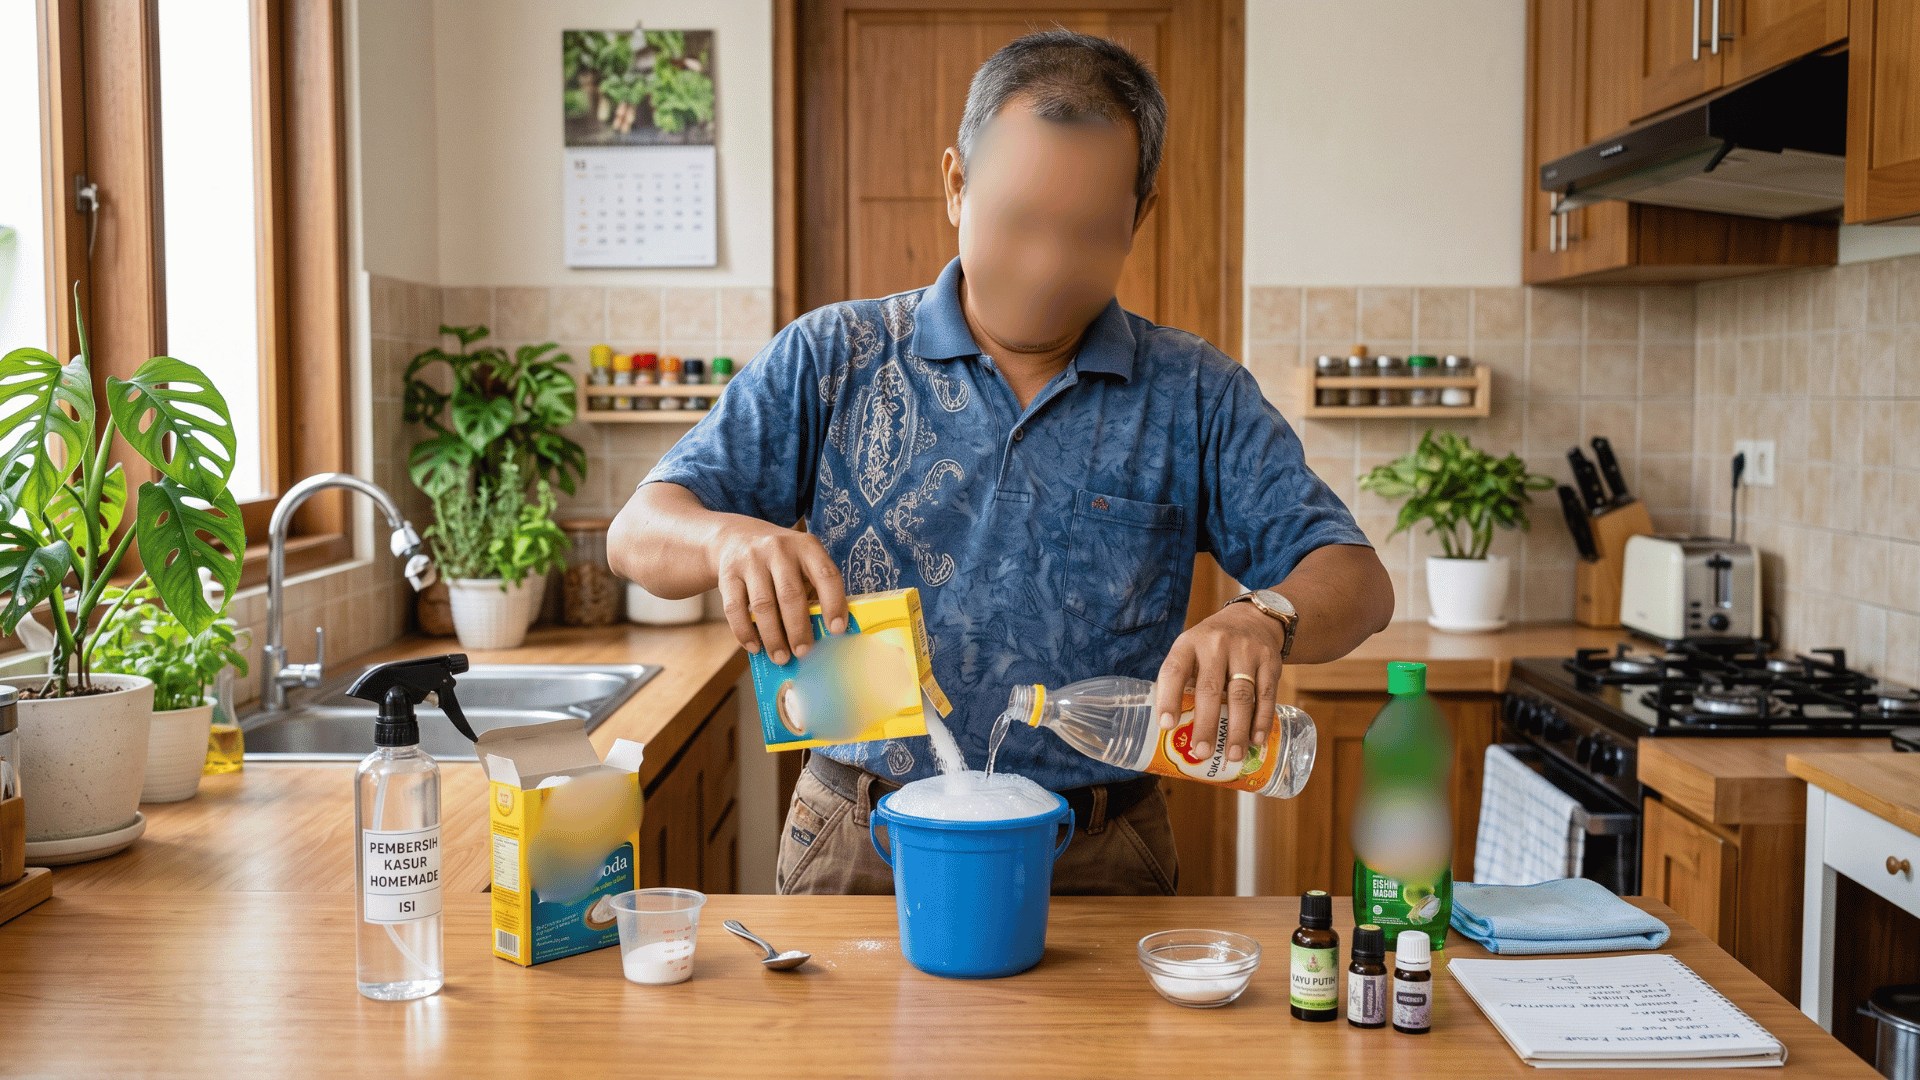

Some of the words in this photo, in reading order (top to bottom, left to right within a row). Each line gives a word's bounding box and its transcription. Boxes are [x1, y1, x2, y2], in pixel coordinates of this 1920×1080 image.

[1207, 755, 1221, 778] CUKA
[1216, 717, 1229, 754] MAKAN
[370, 837, 438, 854] PEMBERSIH
[384, 856, 428, 871] KASUR
[603, 856, 628, 877] oda
[370, 869, 439, 888] HOMEMADE
[399, 900, 416, 913] ISI
[1312, 976, 1336, 986] PUTIH
